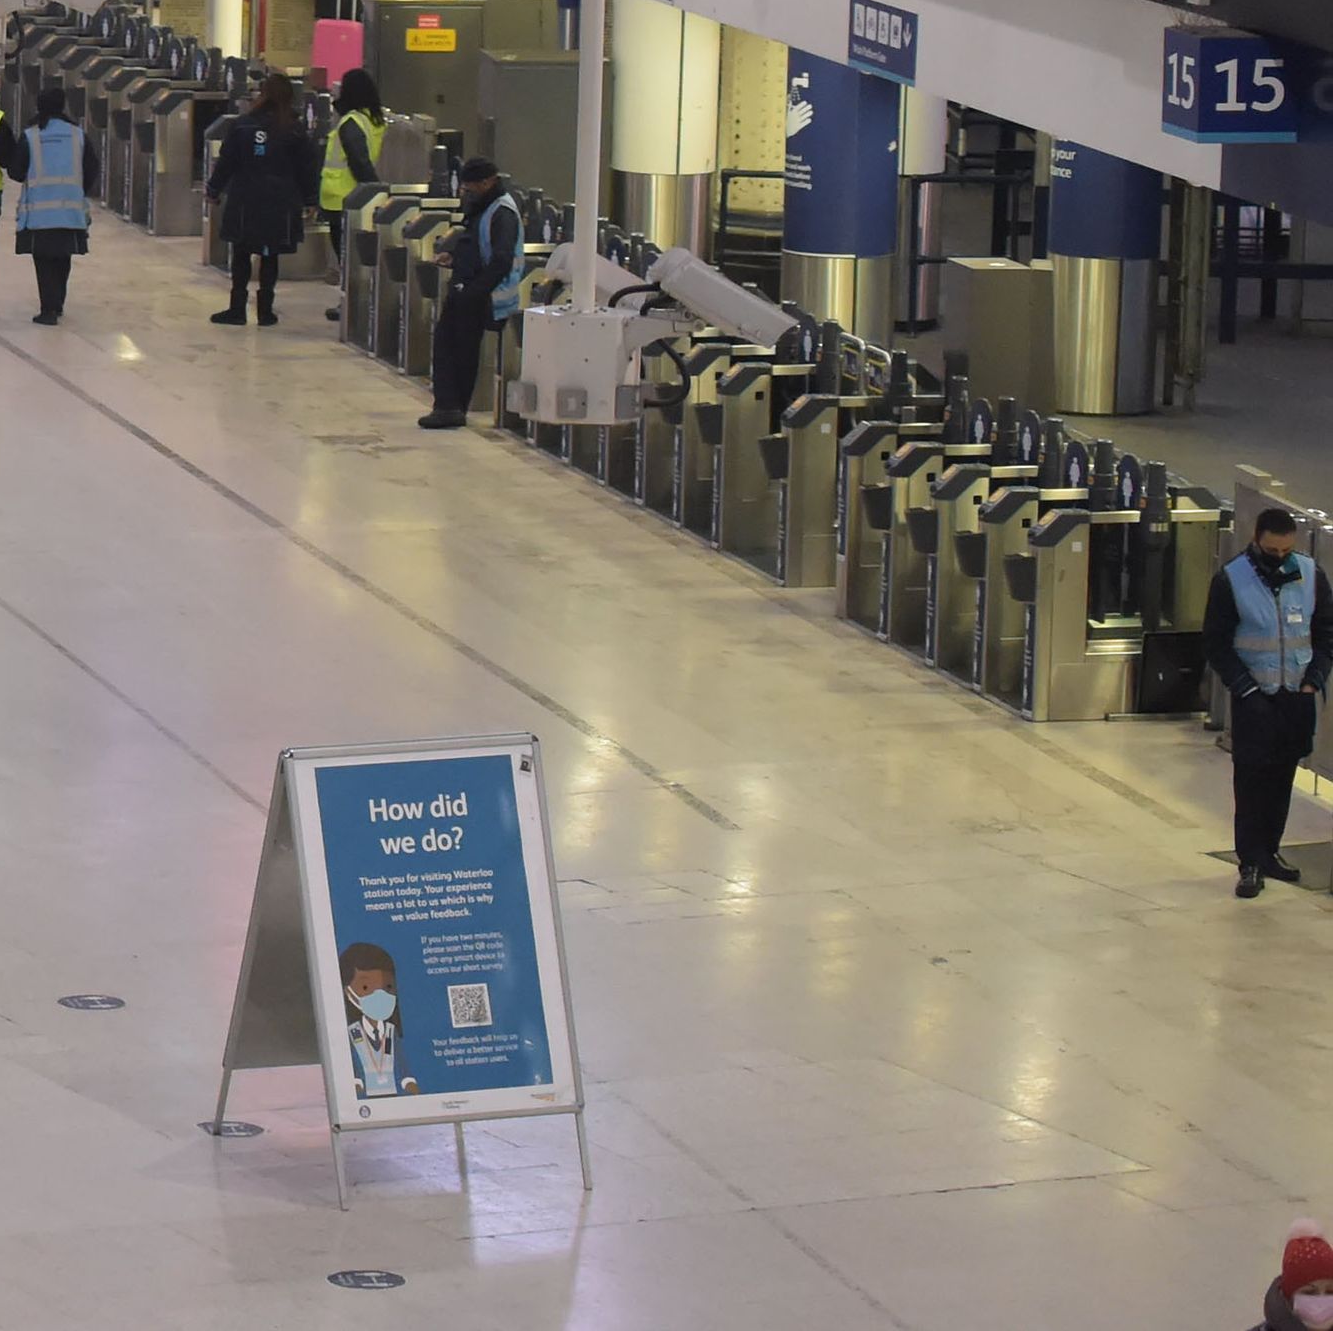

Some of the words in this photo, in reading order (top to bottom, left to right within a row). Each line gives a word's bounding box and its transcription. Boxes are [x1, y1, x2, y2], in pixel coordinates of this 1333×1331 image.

[1167, 52, 1195, 110] 15
[1215, 58, 1286, 113] 15
[1056, 147, 1076, 162] your
[368, 794, 423, 823] How
[430, 791, 468, 819] did
[380, 832, 415, 856] we
[420, 825, 464, 853] do?
[359, 875, 387, 887] Thank
[388, 875, 405, 886] you
[406, 873, 419, 883] for
[421, 870, 453, 882] visiting
[453, 868, 493, 879] Waterloo
[363, 887, 395, 899] station
[396, 886, 423, 898] today.
[424, 884, 444, 895] Your
[445, 881, 493, 895] experience
[365, 902, 394, 911] means
[395, 902, 402, 910] a
[403, 899, 416, 909] lot
[417, 899, 428, 908] to
[429, 899, 439, 907] us
[440, 895, 466, 906] which
[467, 894, 475, 904] is
[476, 893, 494, 905] why
[390, 914, 405, 922] we
[405, 910, 429, 922] value
[430, 907, 472, 920] feedback.
[428, 936, 441, 946] you
[442, 934, 459, 943] have
[462, 942, 473, 951] the
[448, 1035, 479, 1046] feedback
